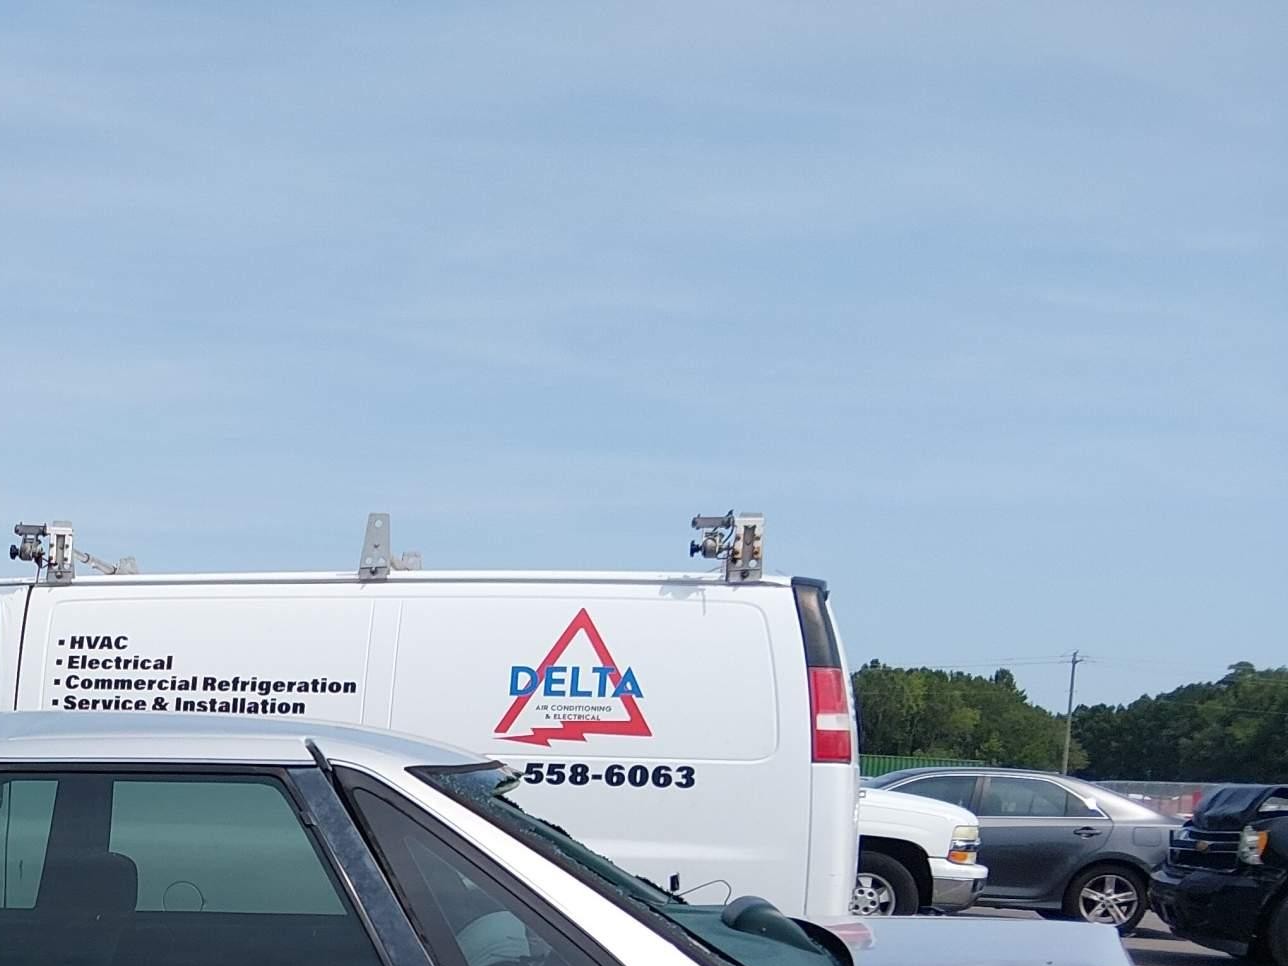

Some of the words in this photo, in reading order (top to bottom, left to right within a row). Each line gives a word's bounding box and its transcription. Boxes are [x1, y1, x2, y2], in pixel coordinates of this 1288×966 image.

[69, 635, 129, 650] HVAC
[67, 655, 174, 671] Electrical
[65, 674, 198, 691] Commercial
[202, 676, 357, 696] Refrigeration
[509, 665, 644, 698] DELTA
[63, 695, 147, 711] Service
[151, 696, 170, 712] &
[174, 697, 306, 715] Installation
[535, 704, 549, 712] AIR
[550, 704, 613, 713] CONDITIONING
[553, 713, 601, 721] ELECTRICAL
[523, 762, 696, 789] 558-6063
